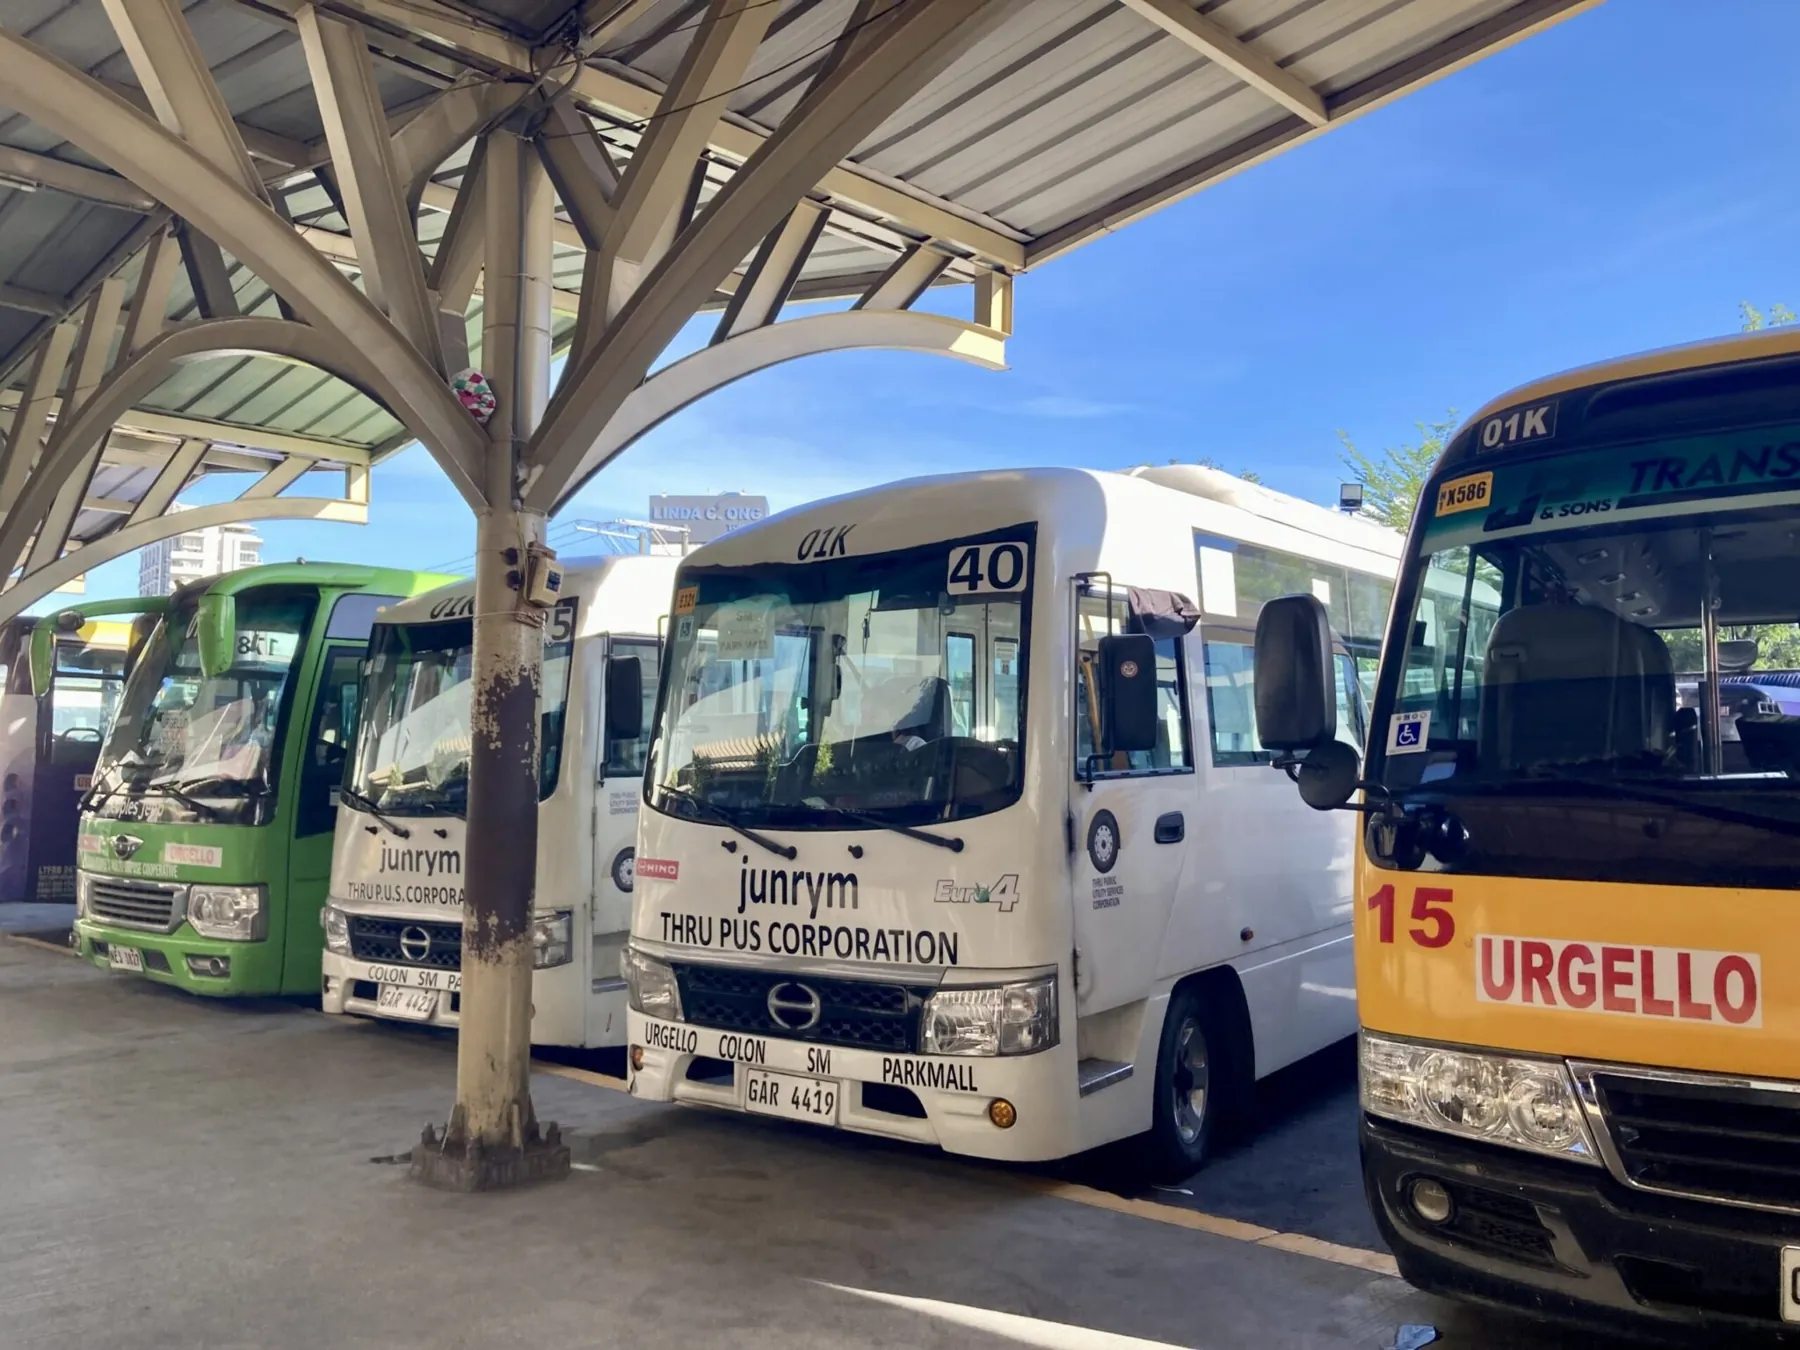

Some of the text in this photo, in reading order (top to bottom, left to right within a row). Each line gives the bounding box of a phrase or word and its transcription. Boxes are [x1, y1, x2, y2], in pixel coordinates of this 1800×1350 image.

[1483, 406, 1549, 447] 01K
[652, 505, 701, 520] LINDA
[725, 506, 761, 521] ONG
[1540, 498, 1612, 520] & SONS
[797, 523, 857, 561] 01K
[949, 544, 1024, 591] 40
[545, 607, 571, 641] 5
[379, 840, 461, 876] junrym
[648, 863, 677, 876] HINO
[348, 882, 374, 900] THRU
[738, 855, 859, 919] junrym
[1367, 884, 1456, 949] 15
[660, 912, 958, 965] THRU PUS CORPORATION
[368, 965, 409, 984] COLON
[418, 971, 438, 987] SM
[1481, 937, 1758, 1025] URGELLO
[645, 1022, 978, 1092] URGELLO COLON SM PARKMALL
[748, 1078, 834, 1116] GAR 4419
